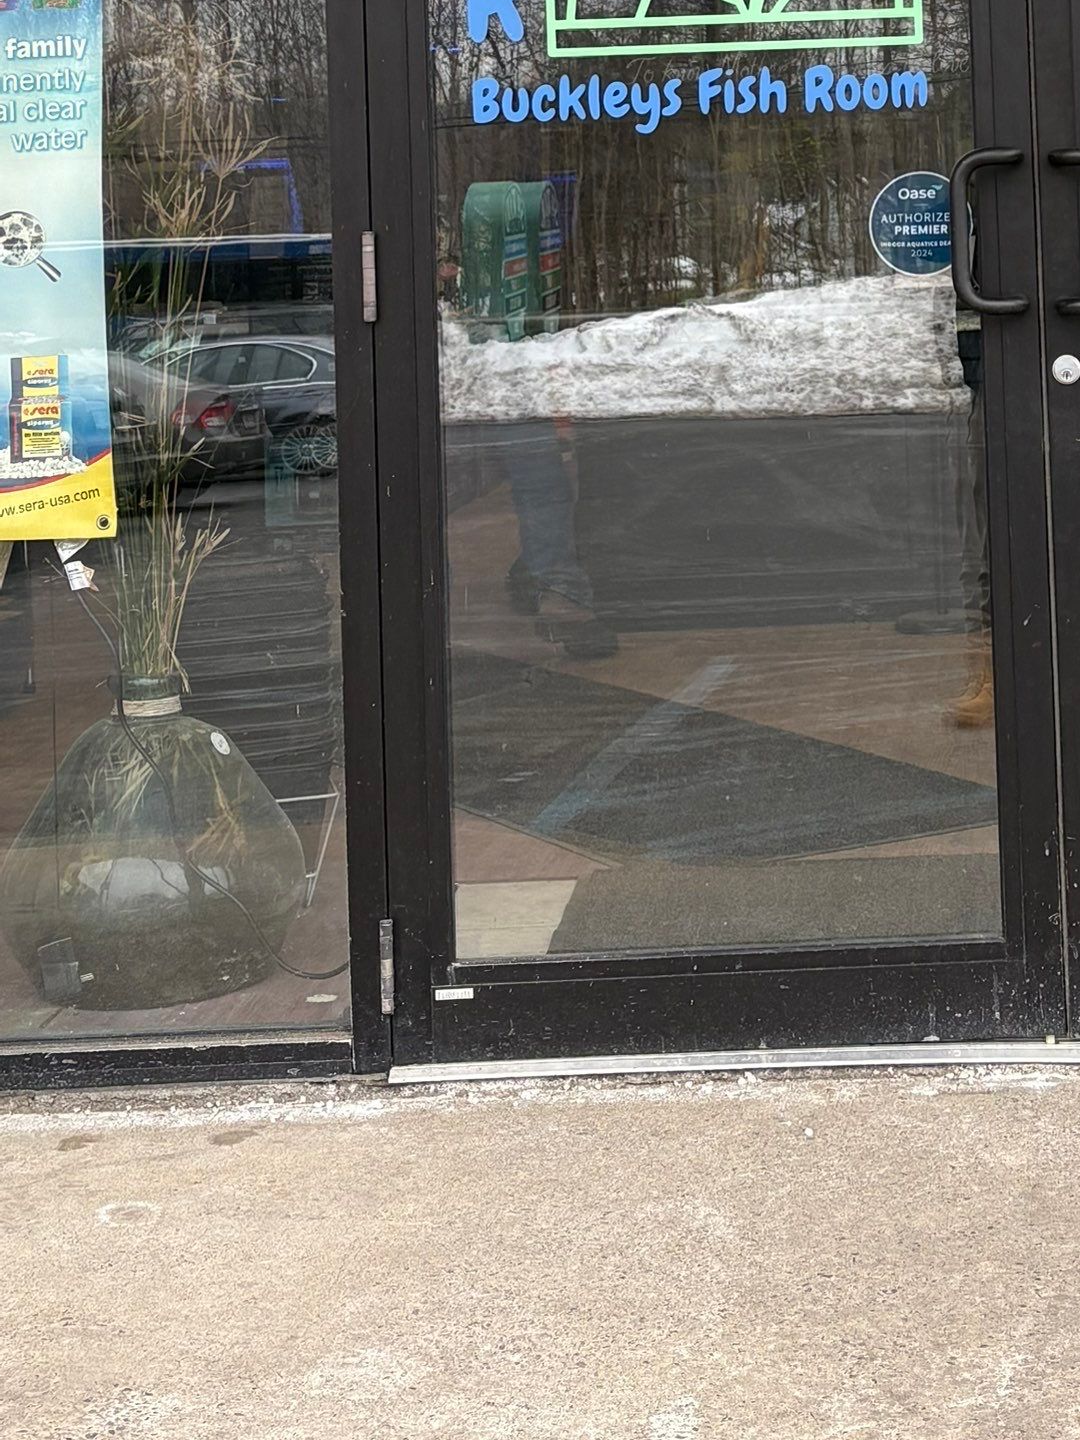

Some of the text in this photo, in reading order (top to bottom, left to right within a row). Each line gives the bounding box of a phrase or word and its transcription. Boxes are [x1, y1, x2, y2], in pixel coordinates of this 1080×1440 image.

[5, 35, 87, 60] family
[471, 64, 929, 135] Buckleys Fish Room
[23, 98, 87, 121] clear
[11, 127, 88, 152] water
[898, 187, 937, 200] Oase
[880, 211, 951, 224] AUTHORIZE
[894, 224, 949, 236] PREMIER
[906, 240, 939, 248] AQUATICS
[911, 249, 933, 258] 2024
[30, 406, 59, 416] sera
